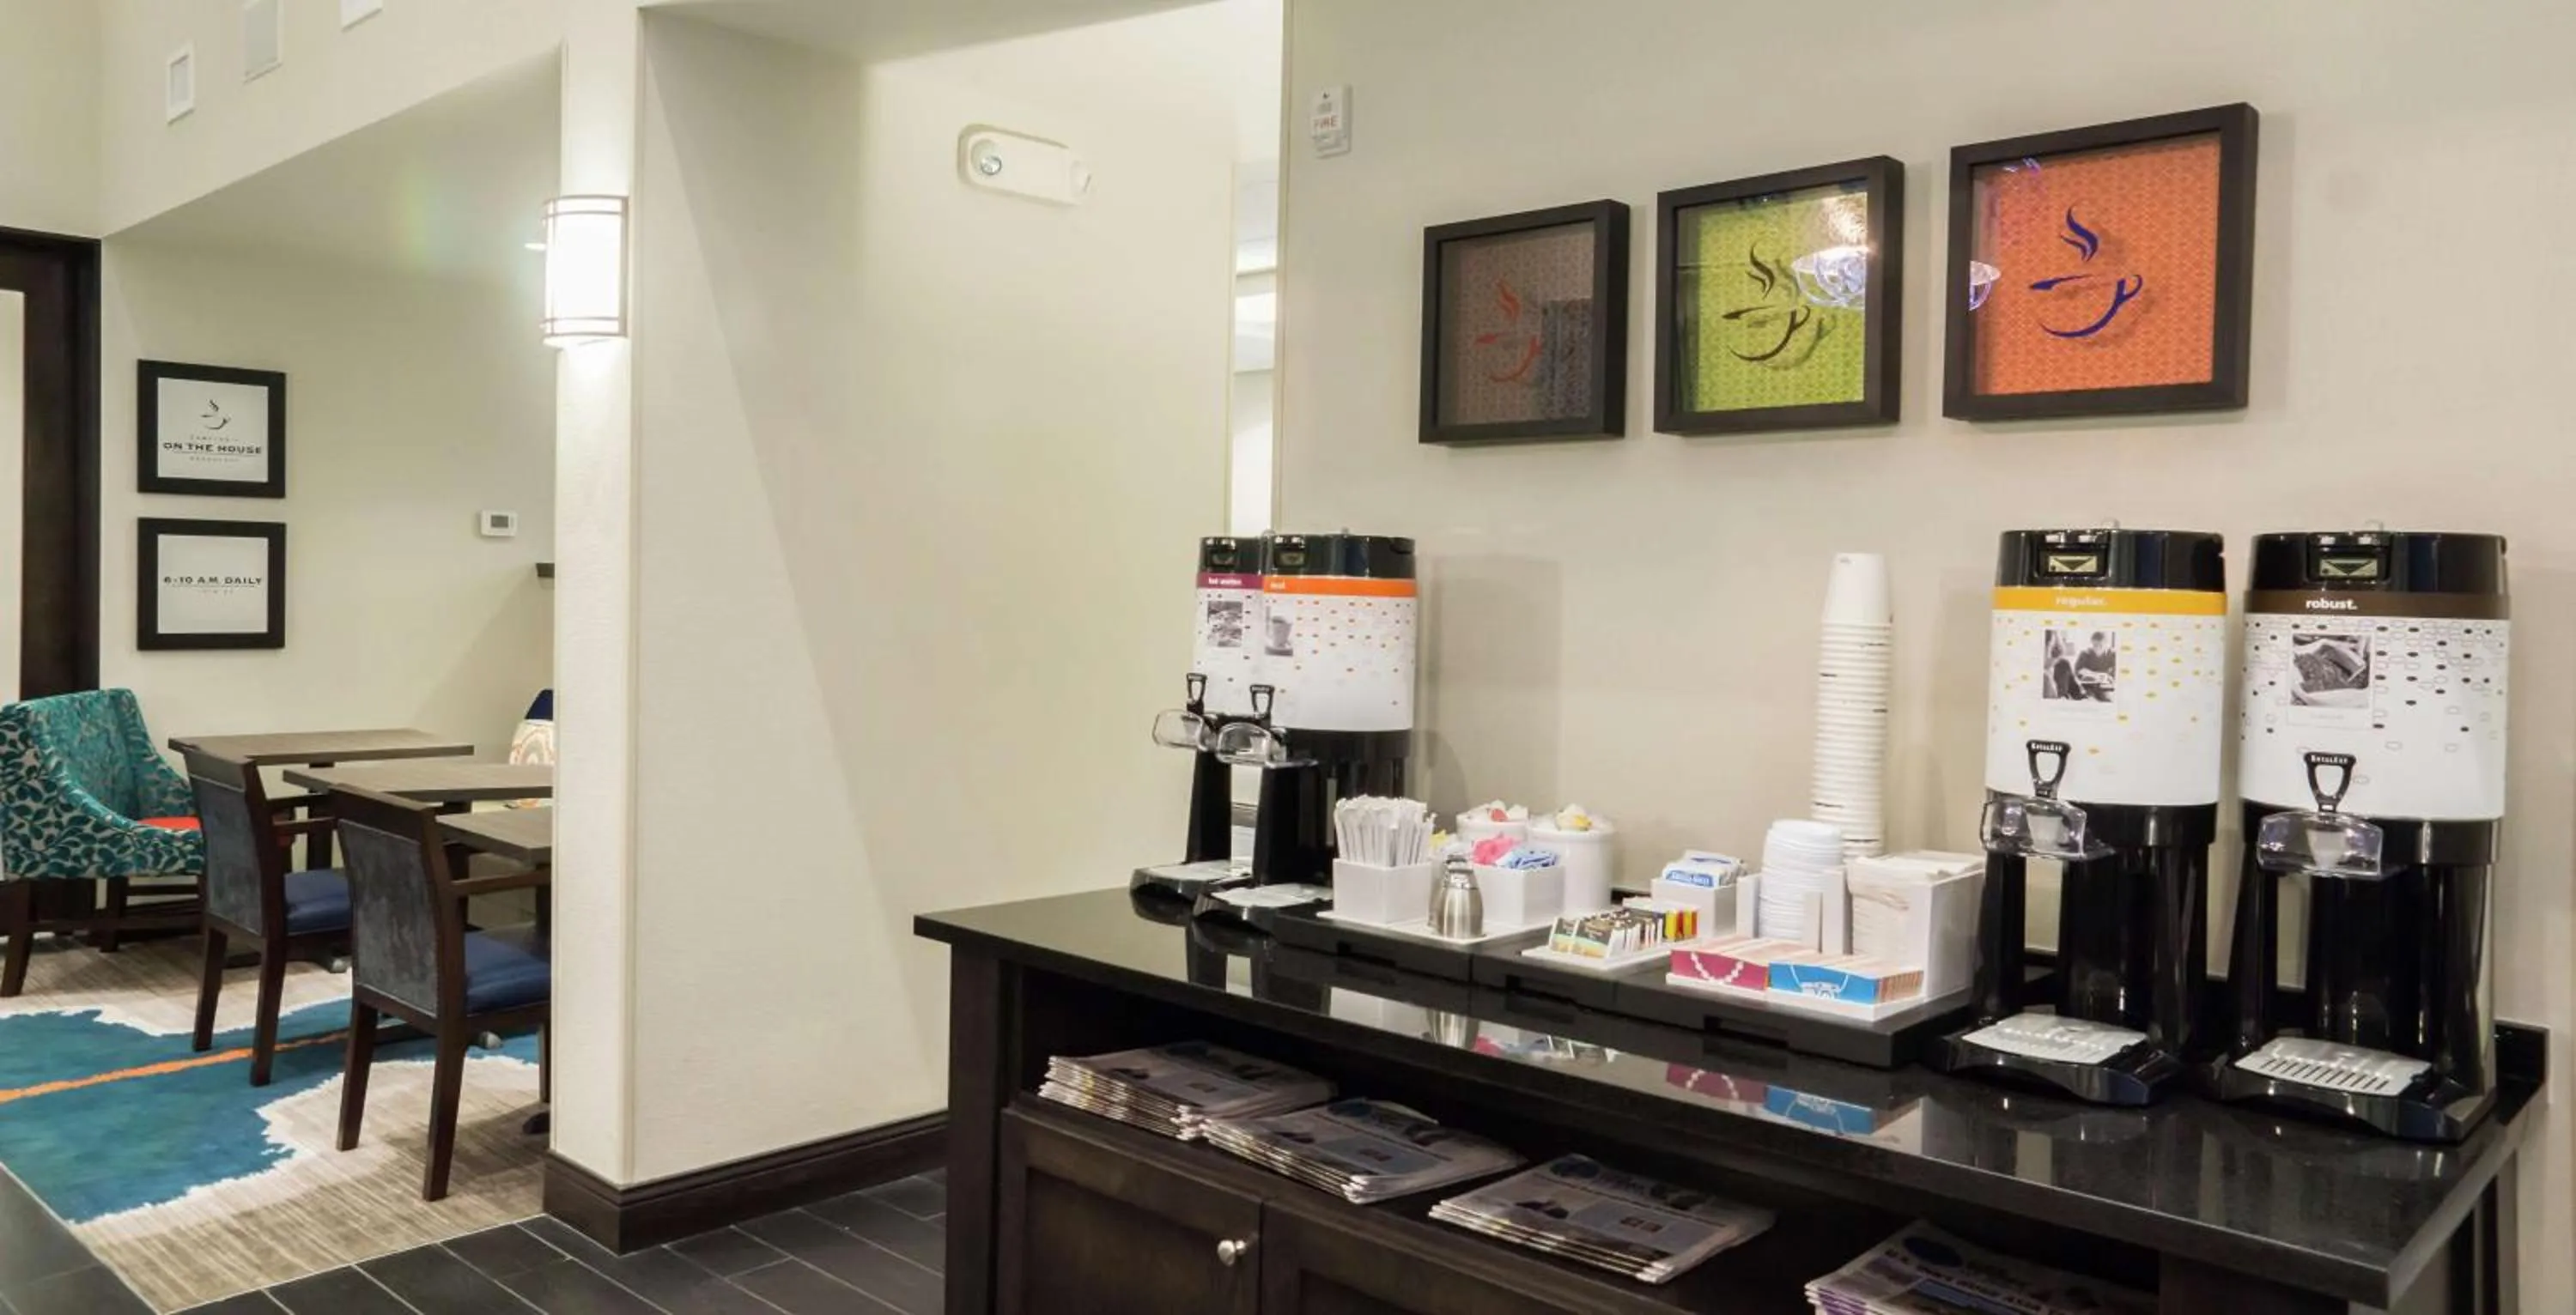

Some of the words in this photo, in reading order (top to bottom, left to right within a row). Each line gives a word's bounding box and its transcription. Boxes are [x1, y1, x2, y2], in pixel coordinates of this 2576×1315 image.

[187, 443, 214, 452] THE
[216, 445, 261, 454] HOUSE
[164, 576, 193, 585] 6-10
[224, 576, 262, 585] DAILY
[2305, 597, 2358, 610] robust.
